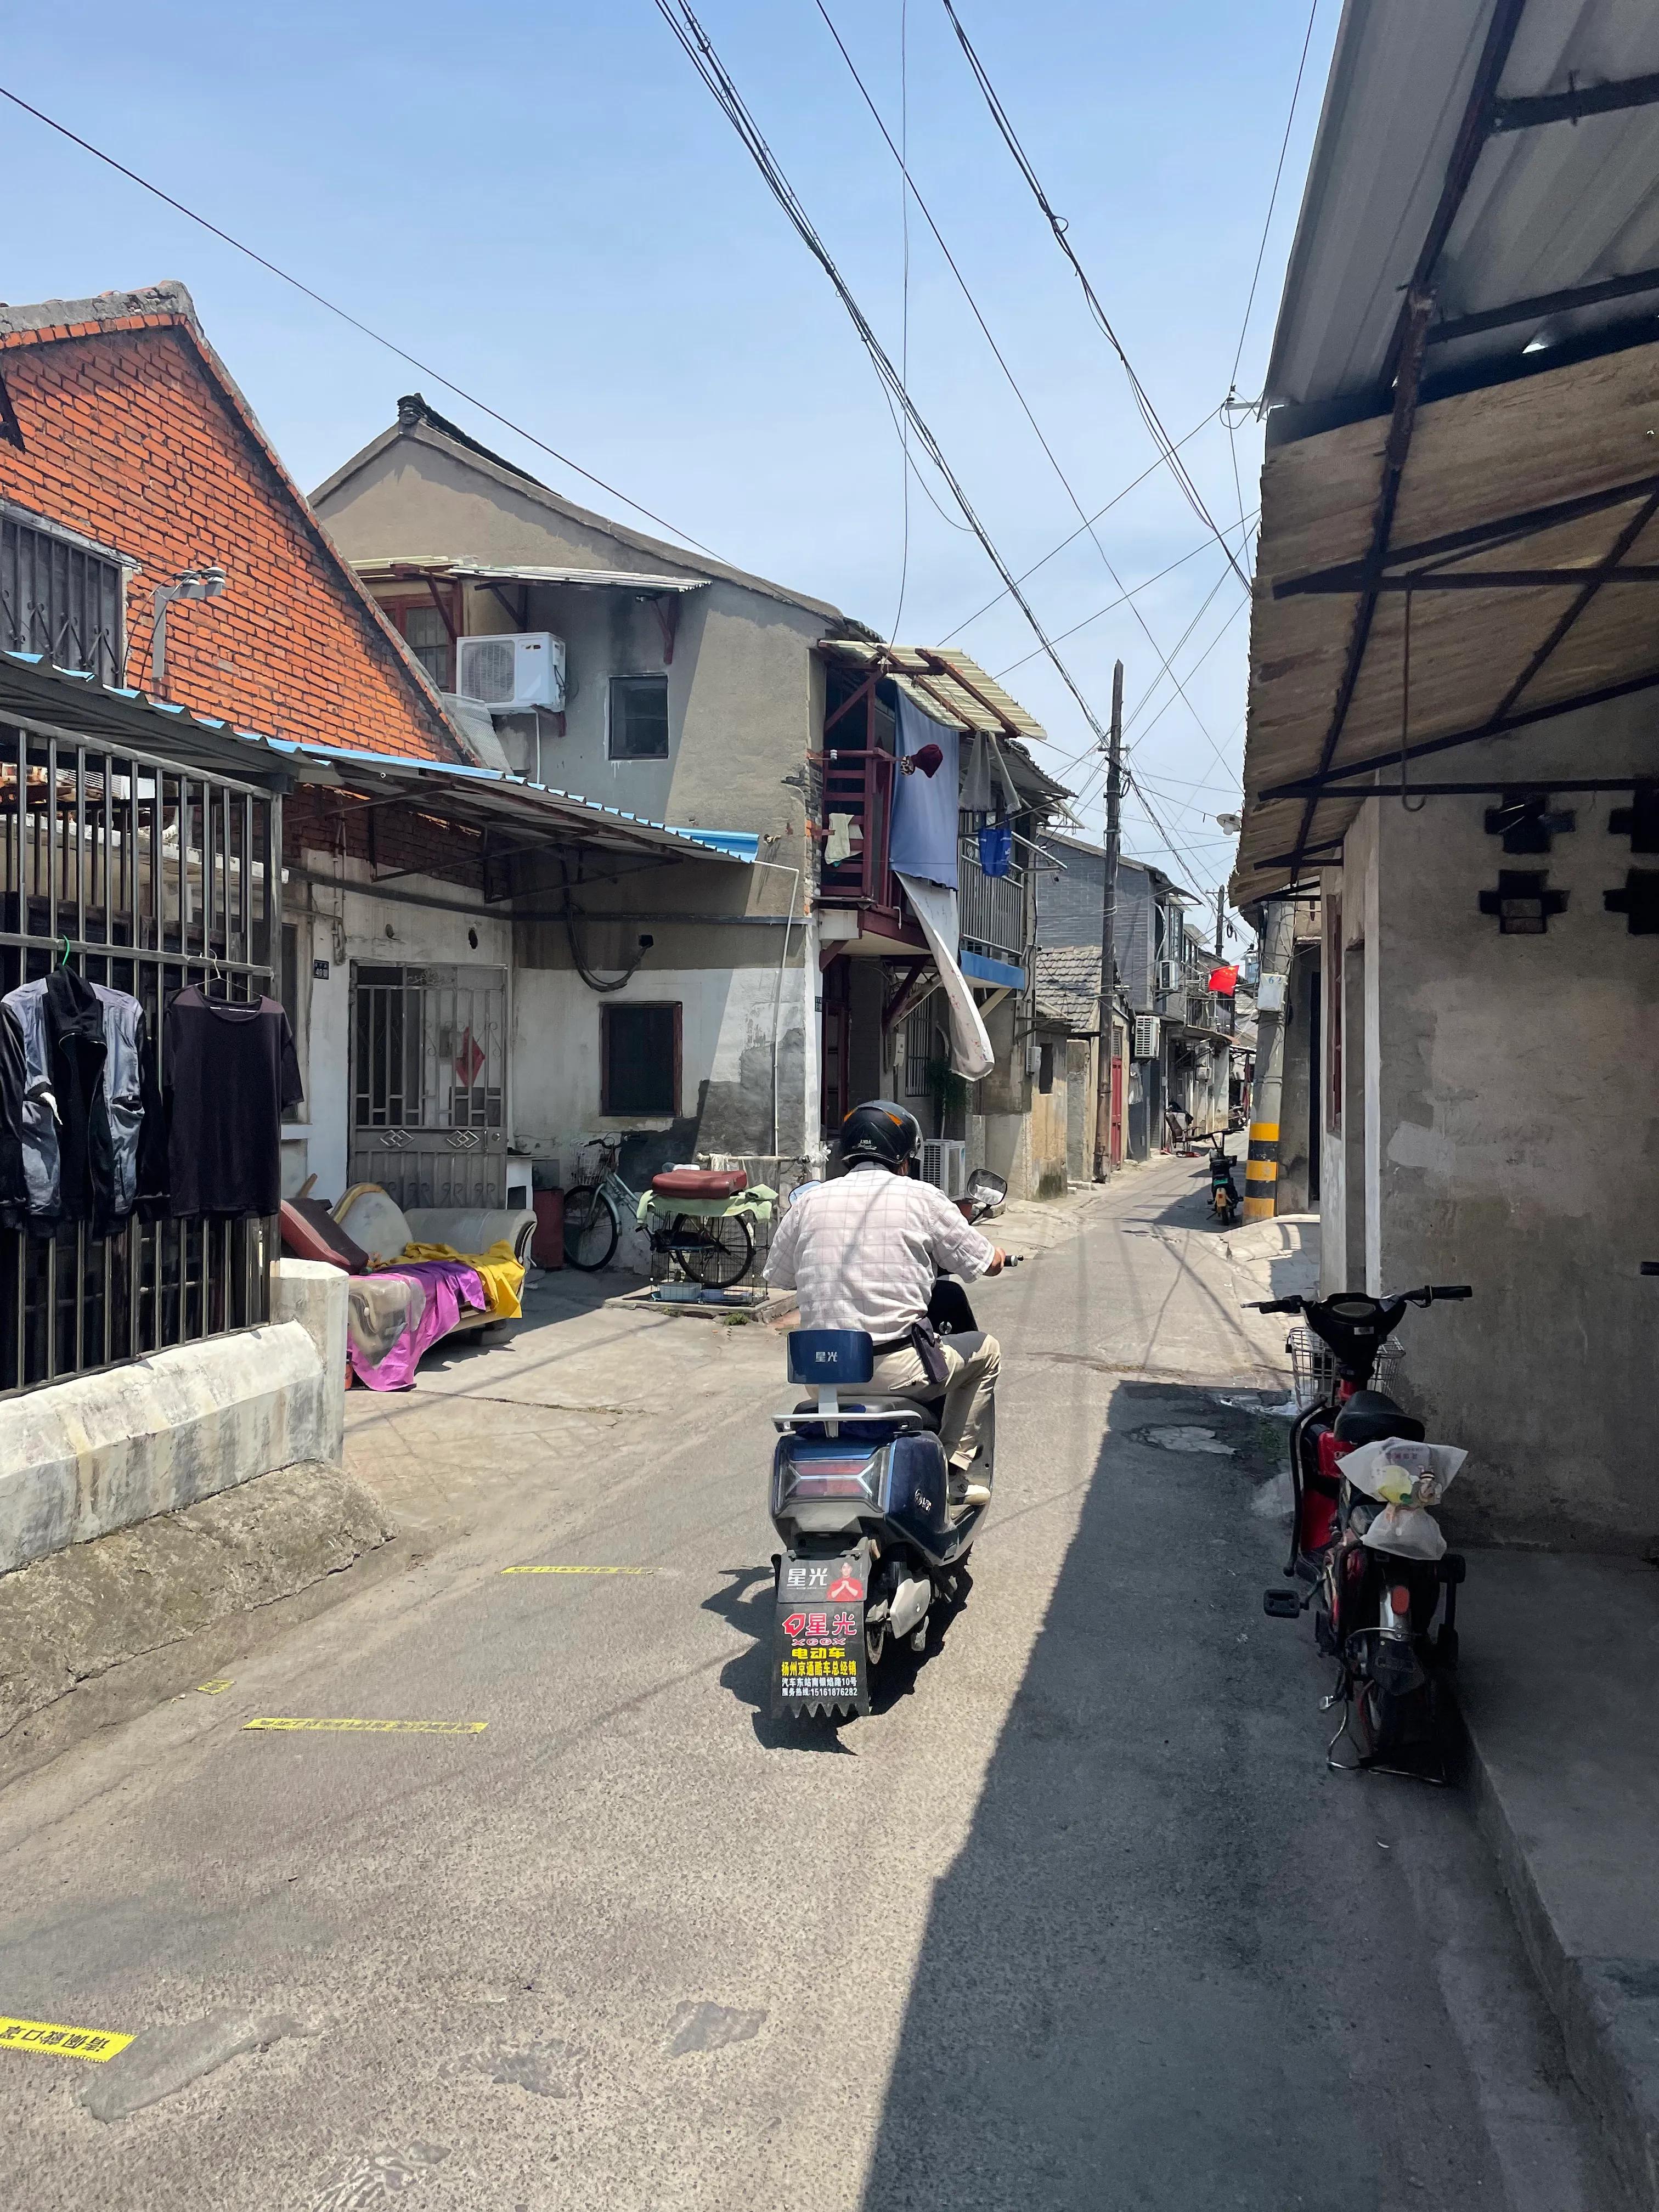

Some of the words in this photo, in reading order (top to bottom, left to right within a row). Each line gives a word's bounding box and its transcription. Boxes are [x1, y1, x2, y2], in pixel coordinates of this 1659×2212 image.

[815, 1351, 838, 1362] 星光
[787, 1568, 828, 1587] 星光
[805, 1612, 857, 1636] 星光
[792, 1647, 845, 1659] 电动车
